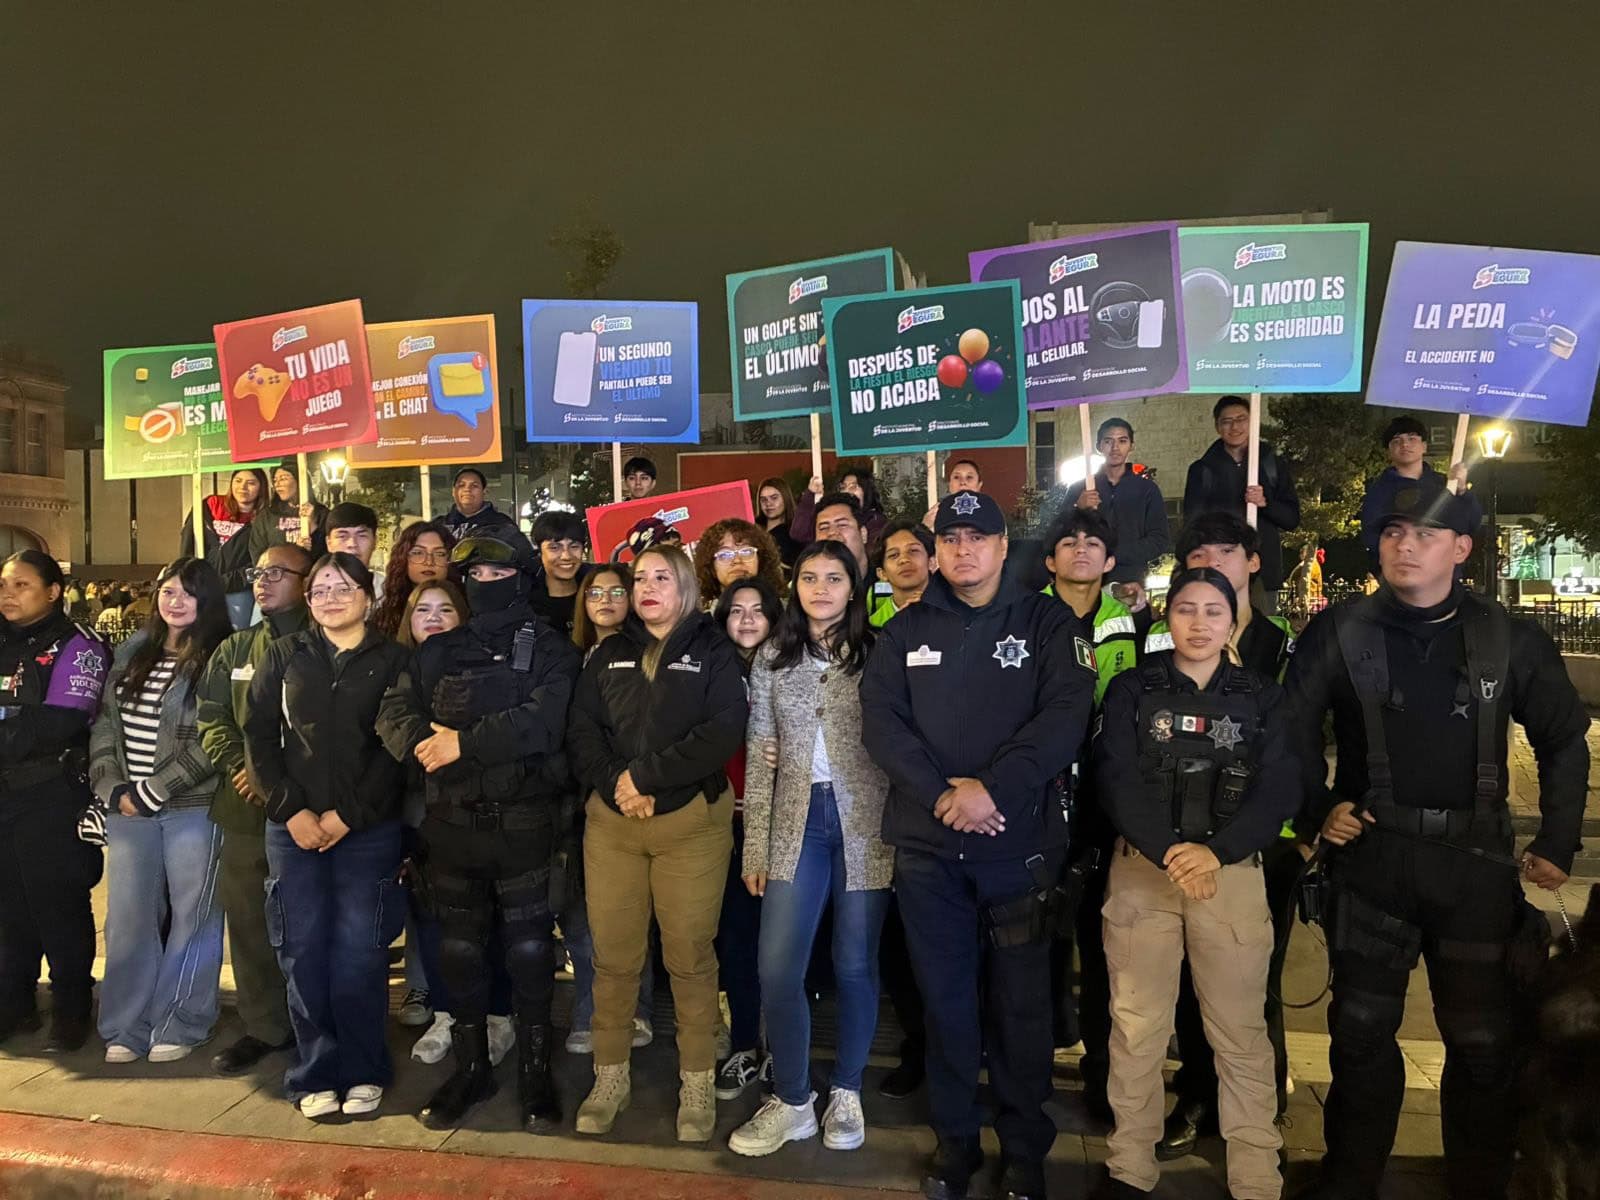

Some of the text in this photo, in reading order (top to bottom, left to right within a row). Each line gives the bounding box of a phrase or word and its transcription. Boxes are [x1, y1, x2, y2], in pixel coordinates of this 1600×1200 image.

[1233, 276, 1344, 308] LA MOTO ES
[1021, 285, 1090, 327] JOS AL
[1413, 302, 1506, 329] LA PEDA
[744, 312, 818, 344] UN GOLPE SIN
[1024, 314, 1090, 353] LANTE
[1230, 315, 1344, 343] ES SEGURIDAD
[284, 339, 350, 380] TU VIDA
[600, 342, 671, 362] UN SEGUNDO
[745, 346, 819, 380] EL ÚLTIMO
[848, 344, 937, 378] DESPUÉS DE
[1026, 341, 1088, 368] AL CELULAR.
[1405, 350, 1495, 363] EL ACCIDENTE NO
[394, 372, 428, 388] CONEXIÓN
[599, 375, 672, 390] PANTALLA PUEDE SER
[600, 359, 649, 380] VIENDO
[851, 365, 938, 390] LA FIESTA EL RIESGO
[184, 382, 220, 396] MANEJAR
[850, 377, 941, 414] NO ACABA
[184, 400, 227, 426] ES M
[305, 389, 342, 417] JUEGO
[384, 401, 397, 419] EL
[400, 397, 428, 416] CHAT
